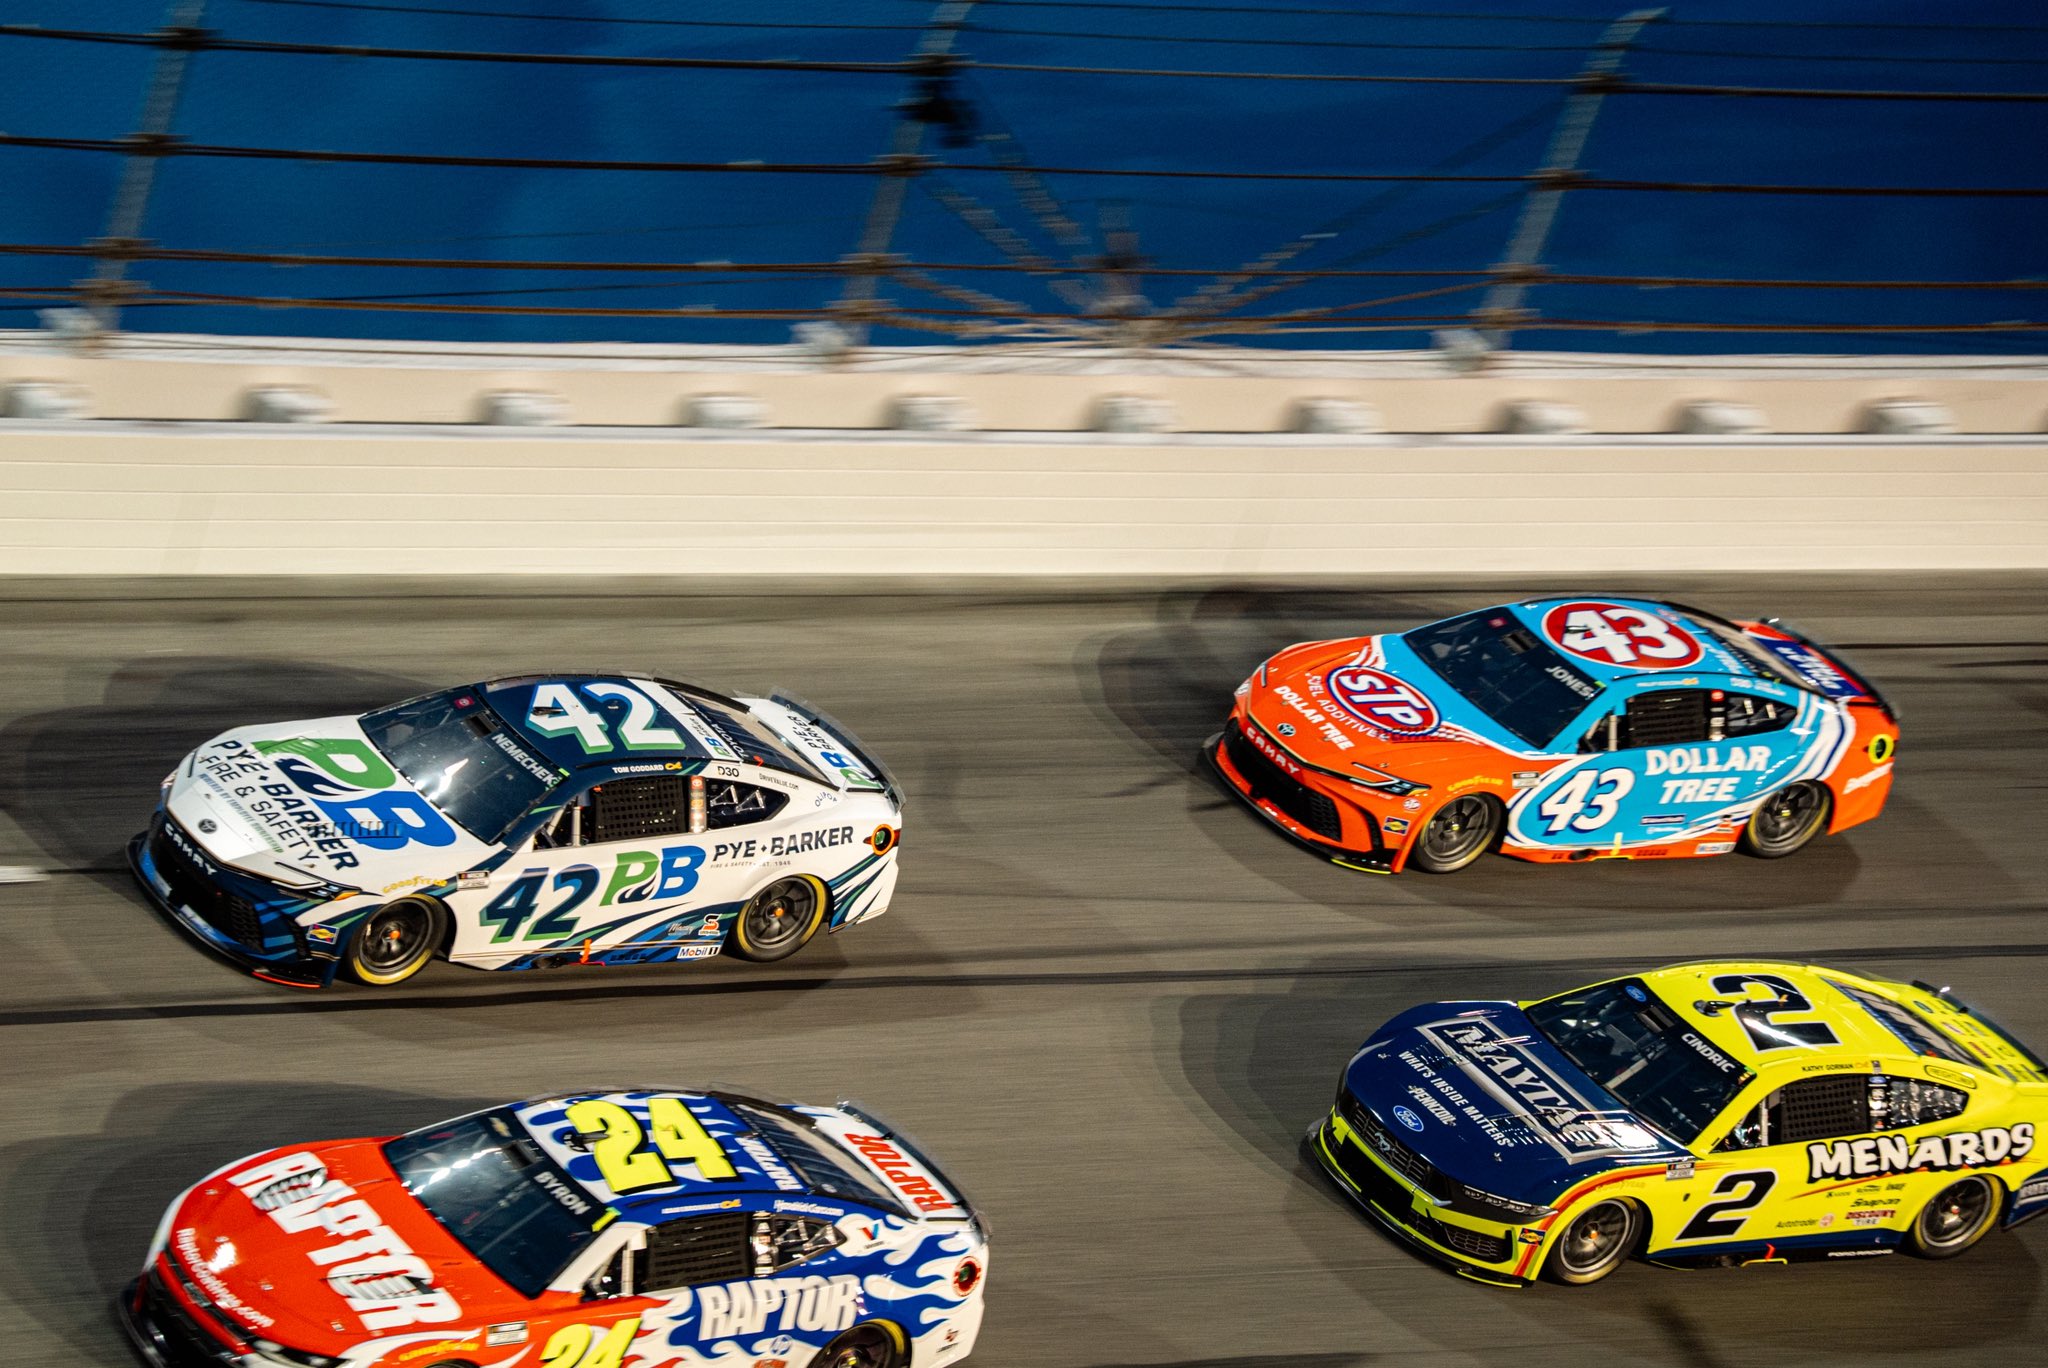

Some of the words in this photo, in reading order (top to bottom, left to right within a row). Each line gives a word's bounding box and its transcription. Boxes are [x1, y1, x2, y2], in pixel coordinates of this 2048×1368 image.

[1561, 608, 1691, 664] 43
[1338, 674, 1428, 726] STP
[1544, 666, 1595, 697] JONES
[525, 682, 686, 754] 42
[711, 723, 749, 757] TOYOTA
[1274, 685, 1326, 723] DOLLAR
[1318, 722, 1355, 750] TREE
[491, 733, 557, 786] NEMECHEK
[612, 766, 630, 774] TOM
[630, 764, 664, 773] GODDARD
[1246, 727, 1299, 774] CAMRY
[1644, 745, 1771, 777] DOLLAR
[198, 755, 242, 782] FIRE
[234, 786, 256, 798] &
[250, 800, 319, 862] SAFETY
[210, 740, 270, 774] PYE
[260, 782, 359, 871] BARKER
[1540, 768, 1635, 833] 43
[1658, 777, 1741, 804] TREE
[165, 823, 218, 875] CAMRY
[712, 839, 756, 862] PYE
[769, 826, 854, 857] BARKER
[478, 864, 600, 944] 42
[1711, 975, 1842, 1053] 2
[1398, 1051, 1436, 1078] WHAT'S
[1430, 1077, 1469, 1106] INSIDE
[1681, 1033, 1735, 1073] CINDRIC
[1397, 1110, 1419, 1128] Ford
[1413, 1086, 1457, 1125] PENNZOIL
[565, 1098, 738, 1193] 24
[844, 1133, 955, 1212] RAPTOR
[1807, 1123, 2036, 1183] MENARDS
[534, 1171, 591, 1215] BYRON
[1675, 1169, 1776, 1241] 2
[695, 1274, 861, 1341] RAPTOR
